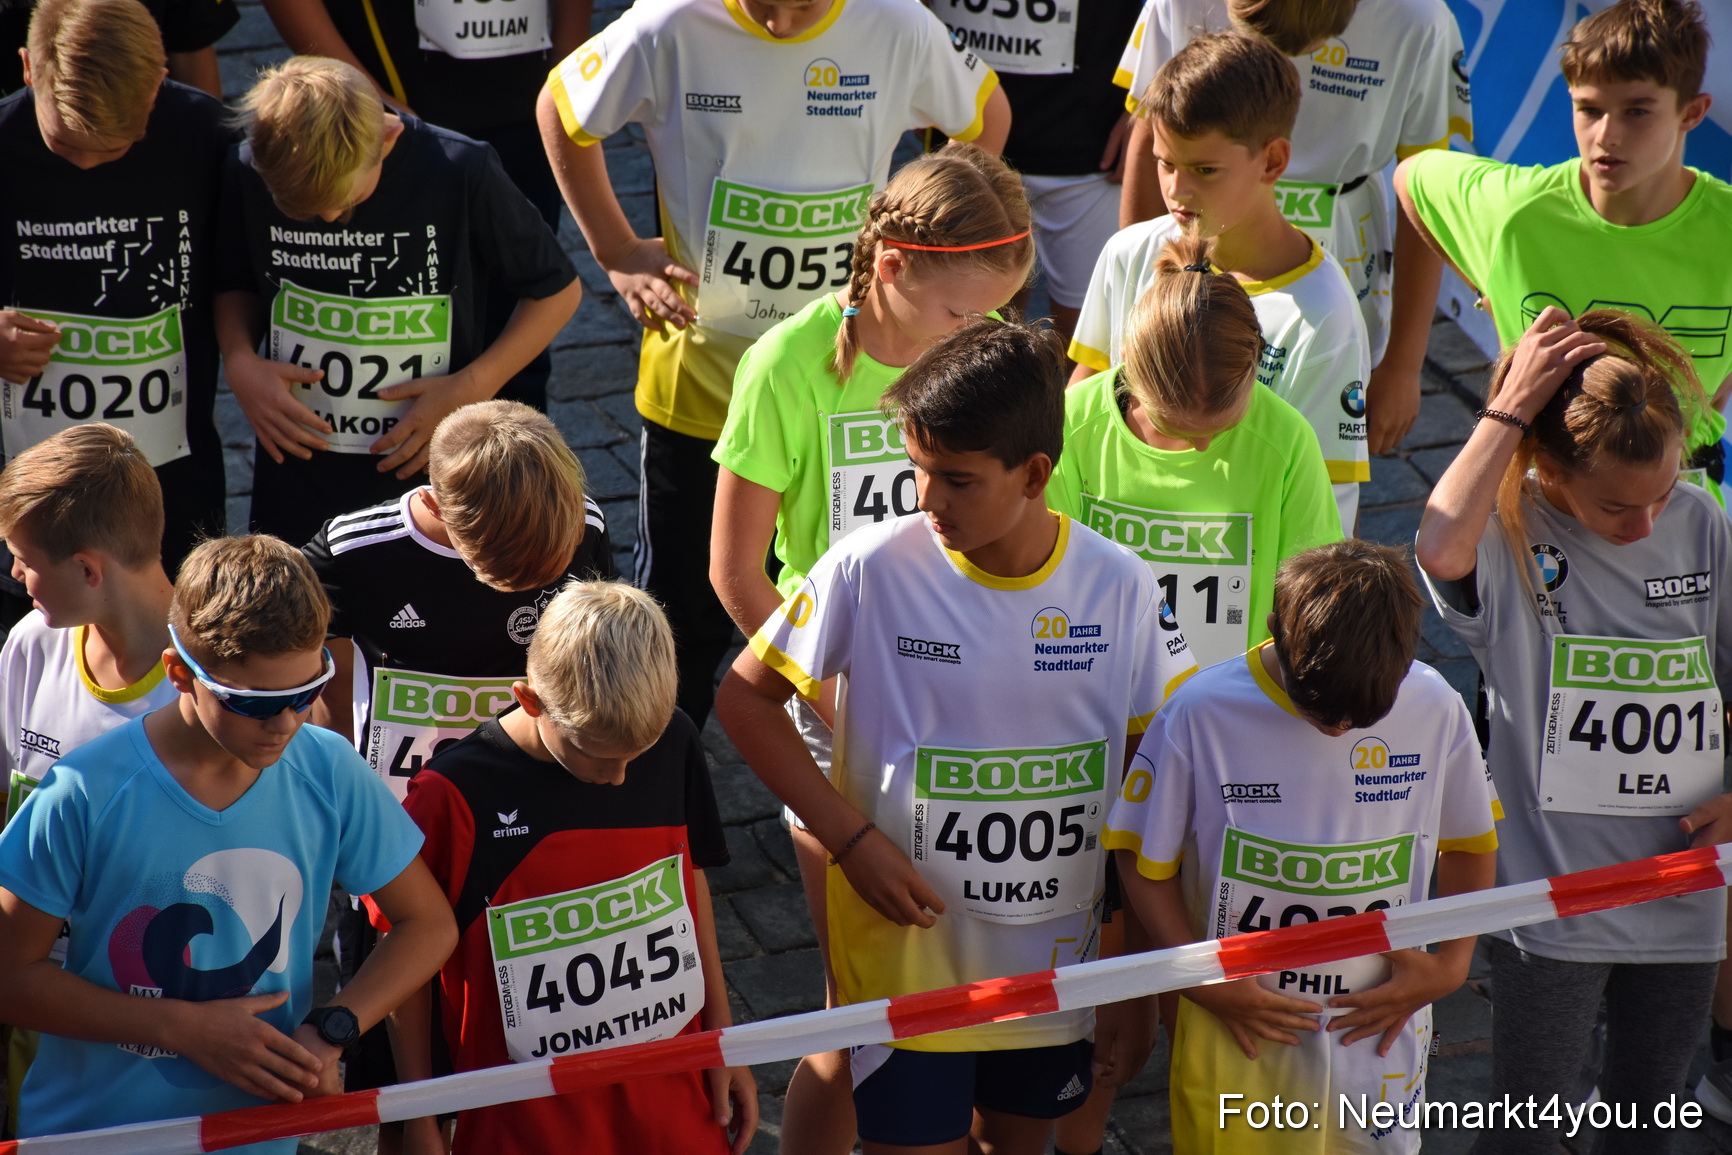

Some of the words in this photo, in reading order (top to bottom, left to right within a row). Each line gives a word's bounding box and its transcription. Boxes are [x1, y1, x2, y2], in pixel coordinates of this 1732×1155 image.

[455, 17, 528, 40] JULIAN
[946, 23, 1042, 56] OMINIK
[1313, 44, 1346, 66] 20
[1348, 58, 1377, 70] JAHRE
[808, 66, 839, 87] 20
[842, 76, 867, 86] JAHRE
[1311, 65, 1385, 87] Neumarkter
[686, 93, 742, 109] BOCK
[807, 90, 877, 101] Neumarkter
[1309, 79, 1369, 101] Stadtlauf
[806, 104, 864, 118] Stadtlauf
[725, 189, 864, 232] BOCK
[17, 217, 139, 237] Neumarkter
[270, 226, 385, 247] Neumarkter
[19, 240, 117, 262] Stadtlauf
[271, 250, 363, 274] Stadtlauf
[426, 225, 439, 294] BAMBI
[723, 240, 854, 292] 4053
[284, 290, 436, 338] BOCK
[50, 318, 174, 360] OCK
[22, 369, 170, 420] 4020
[1339, 423, 1367, 433] PART
[853, 470, 921, 523] 40
[1090, 503, 1234, 560] BOCK
[1232, 580, 1240, 590] J
[1644, 571, 1711, 600] BOCK
[1157, 573, 1219, 624] 11
[389, 618, 426, 629] adidas
[1035, 616, 1066, 639] 20
[1072, 626, 1099, 637] JAHRE
[898, 636, 961, 660] BOCK
[1035, 642, 1109, 655] Neumarkter
[1034, 658, 1094, 672] Stadtlauf
[1567, 645, 1710, 687] BOCK
[388, 678, 512, 722] BOC
[1569, 700, 1705, 755] 4001
[1355, 745, 1387, 769] 20
[1391, 756, 1418, 767] JAHRE
[930, 749, 1094, 795] BOCK
[1355, 770, 1427, 786] Neumarkter
[1221, 784, 1281, 799] BOCK
[1355, 787, 1412, 803] Stadtlauf
[1618, 774, 1671, 795] LEA
[493, 826, 529, 838] erima
[935, 804, 1086, 863] 4005
[1236, 837, 1403, 889] BOCK
[964, 877, 1059, 903] LUKAS
[504, 868, 675, 952] BOCK
[526, 925, 680, 1014] 4045
[1279, 970, 1350, 995] PHIL
[531, 993, 687, 1058] JONATHAN
[1057, 1089, 1085, 1102] adidas
